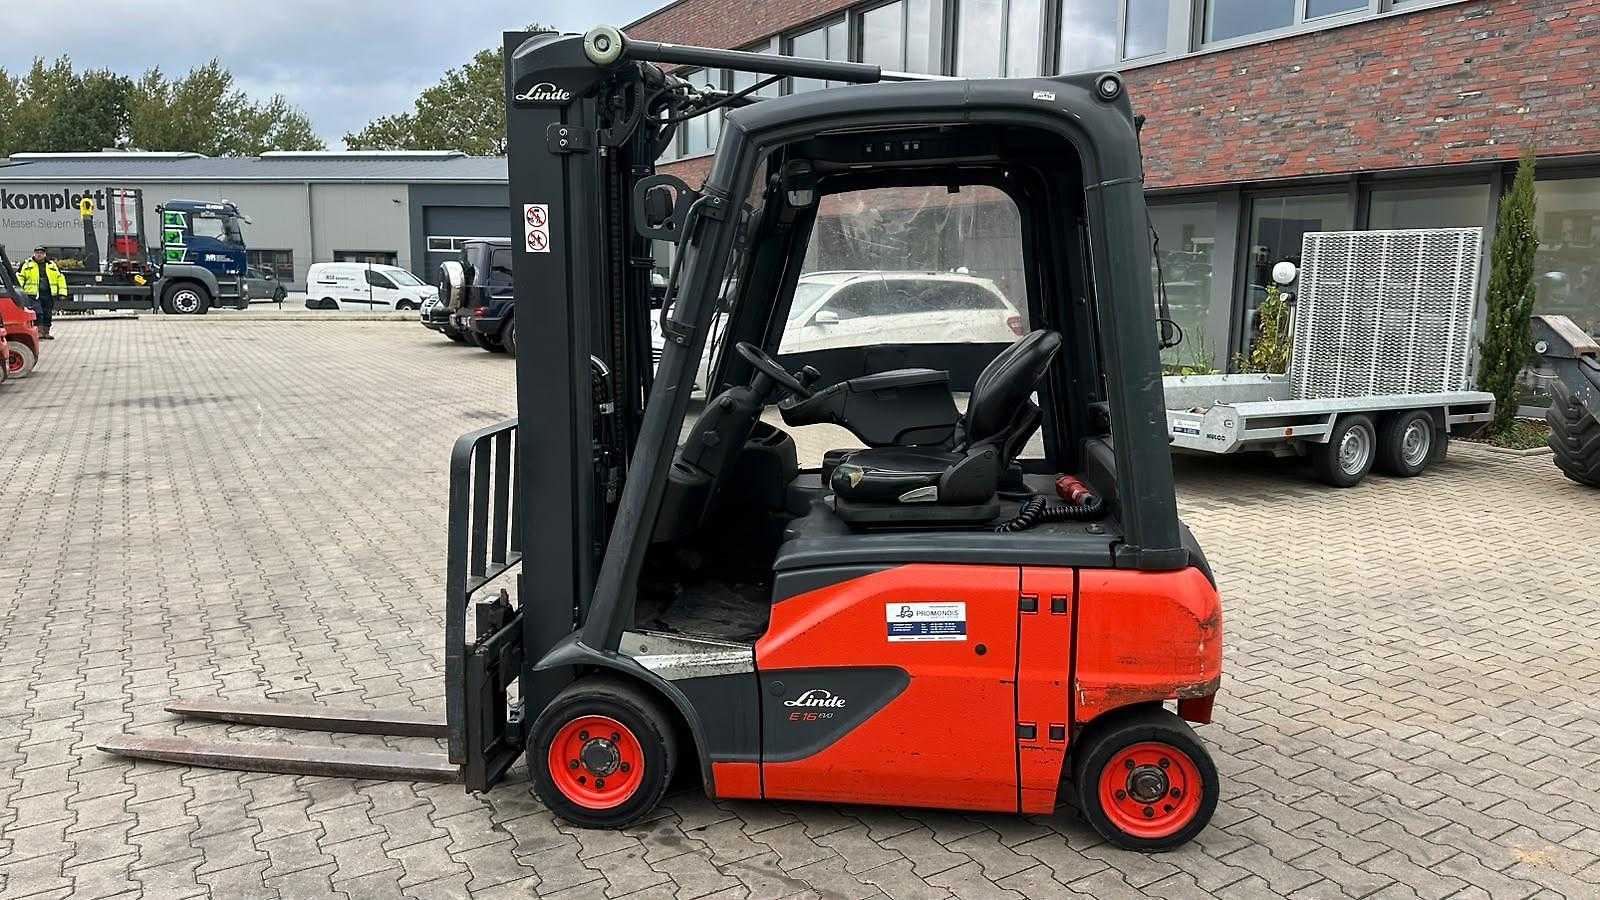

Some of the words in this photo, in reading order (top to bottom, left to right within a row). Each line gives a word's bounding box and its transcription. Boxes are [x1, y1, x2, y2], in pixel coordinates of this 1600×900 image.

[515, 82, 571, 101] Linde
[0, 188, 106, 212] komplett
[783, 689, 846, 708] Linde
[789, 712, 801, 721] E
[802, 712, 818, 721] 16
